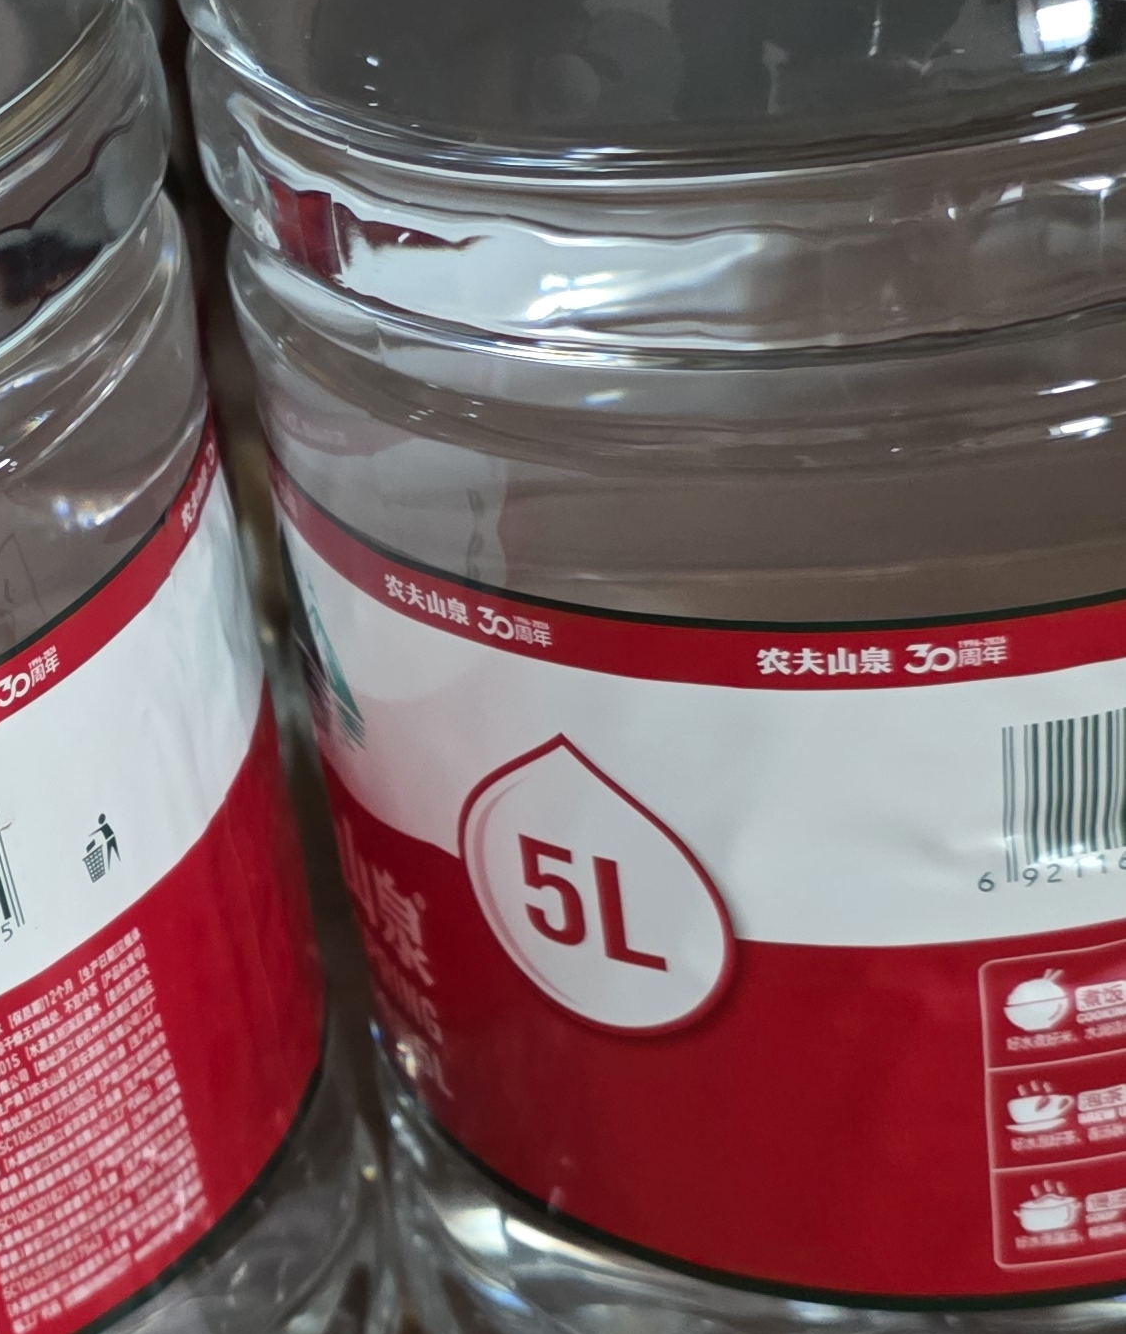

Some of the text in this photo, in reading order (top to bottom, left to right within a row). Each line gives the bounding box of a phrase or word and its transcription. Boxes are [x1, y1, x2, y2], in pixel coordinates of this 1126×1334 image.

[384, 573, 470, 626] 农夫山泉
[756, 646, 893, 675] 农夫山泉
[518, 833, 669, 972] 5L
